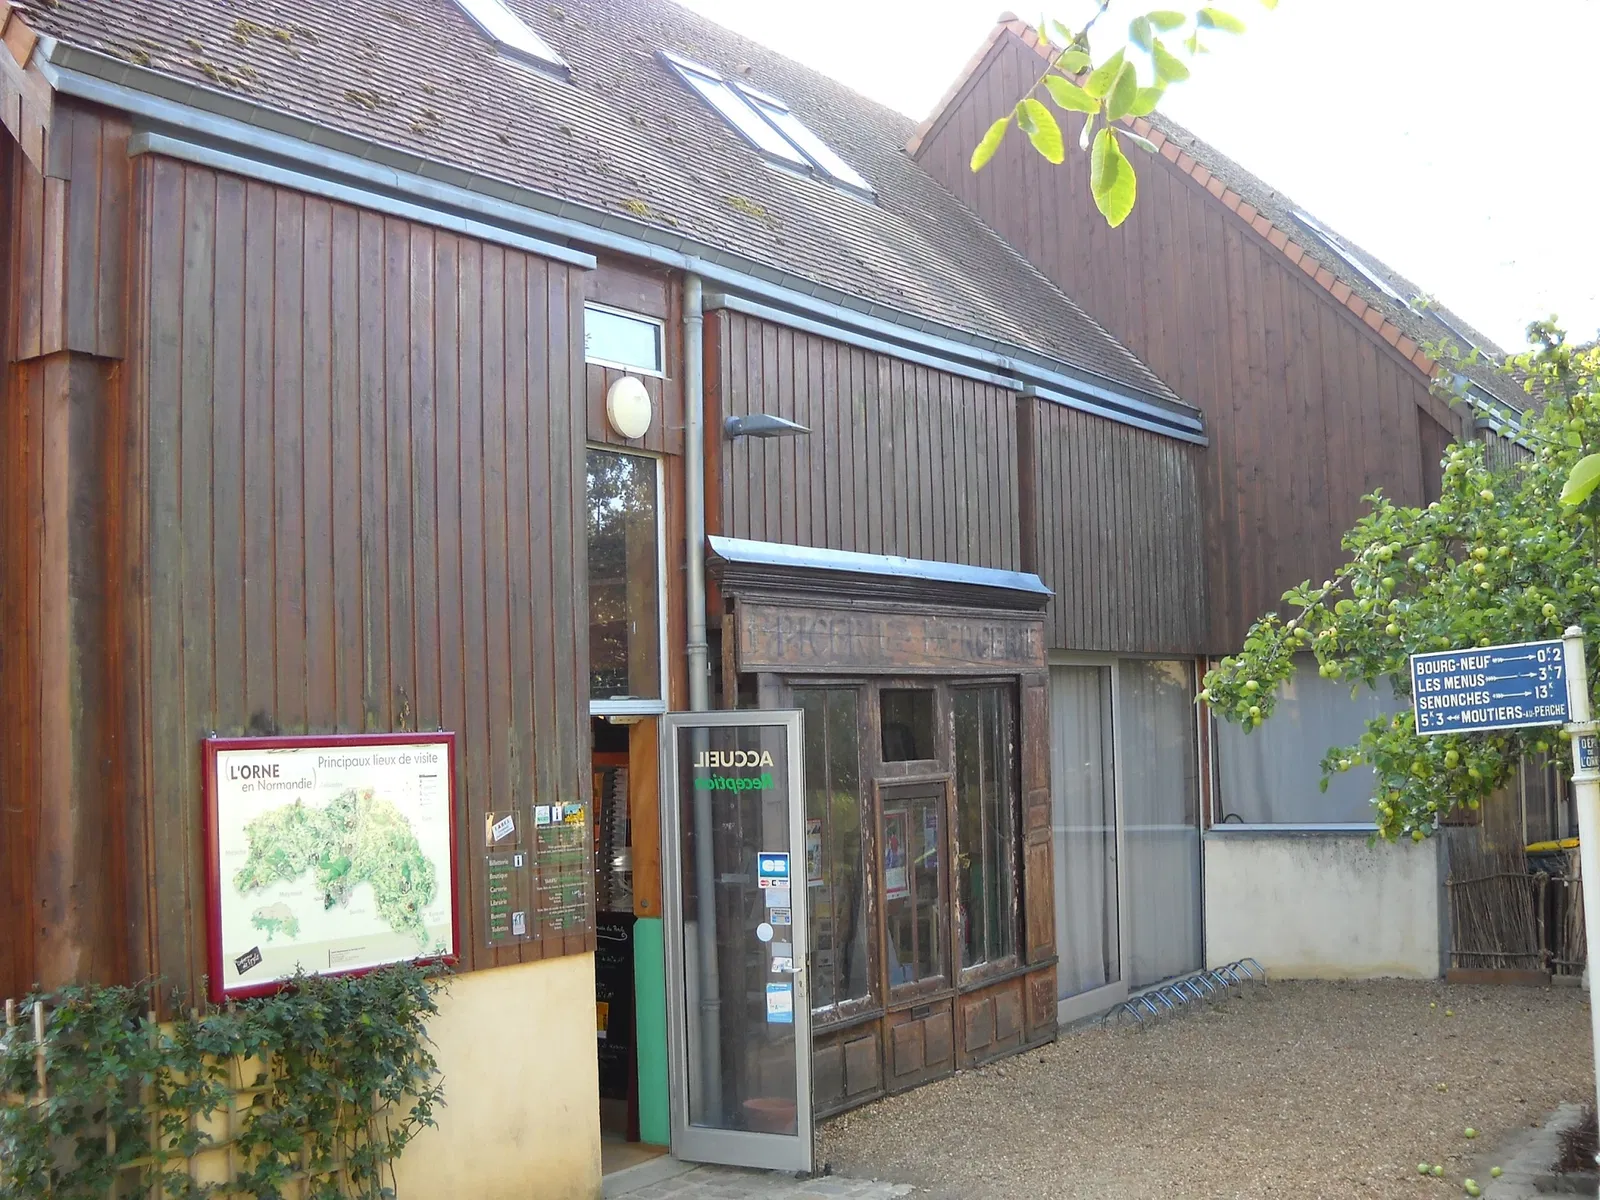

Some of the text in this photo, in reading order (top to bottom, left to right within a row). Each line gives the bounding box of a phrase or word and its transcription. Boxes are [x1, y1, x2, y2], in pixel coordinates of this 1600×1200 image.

[1416, 655, 1491, 675] BOURG-NEUF
[1418, 678, 1442, 693] LES
[1444, 673, 1486, 690] MENUS
[1419, 691, 1490, 710] SENONCHES
[318, 751, 439, 770] Principaux lieux de visite
[230, 764, 280, 780] L'ORNE
[241, 783, 255, 793] en
[257, 777, 313, 792] Normandie
